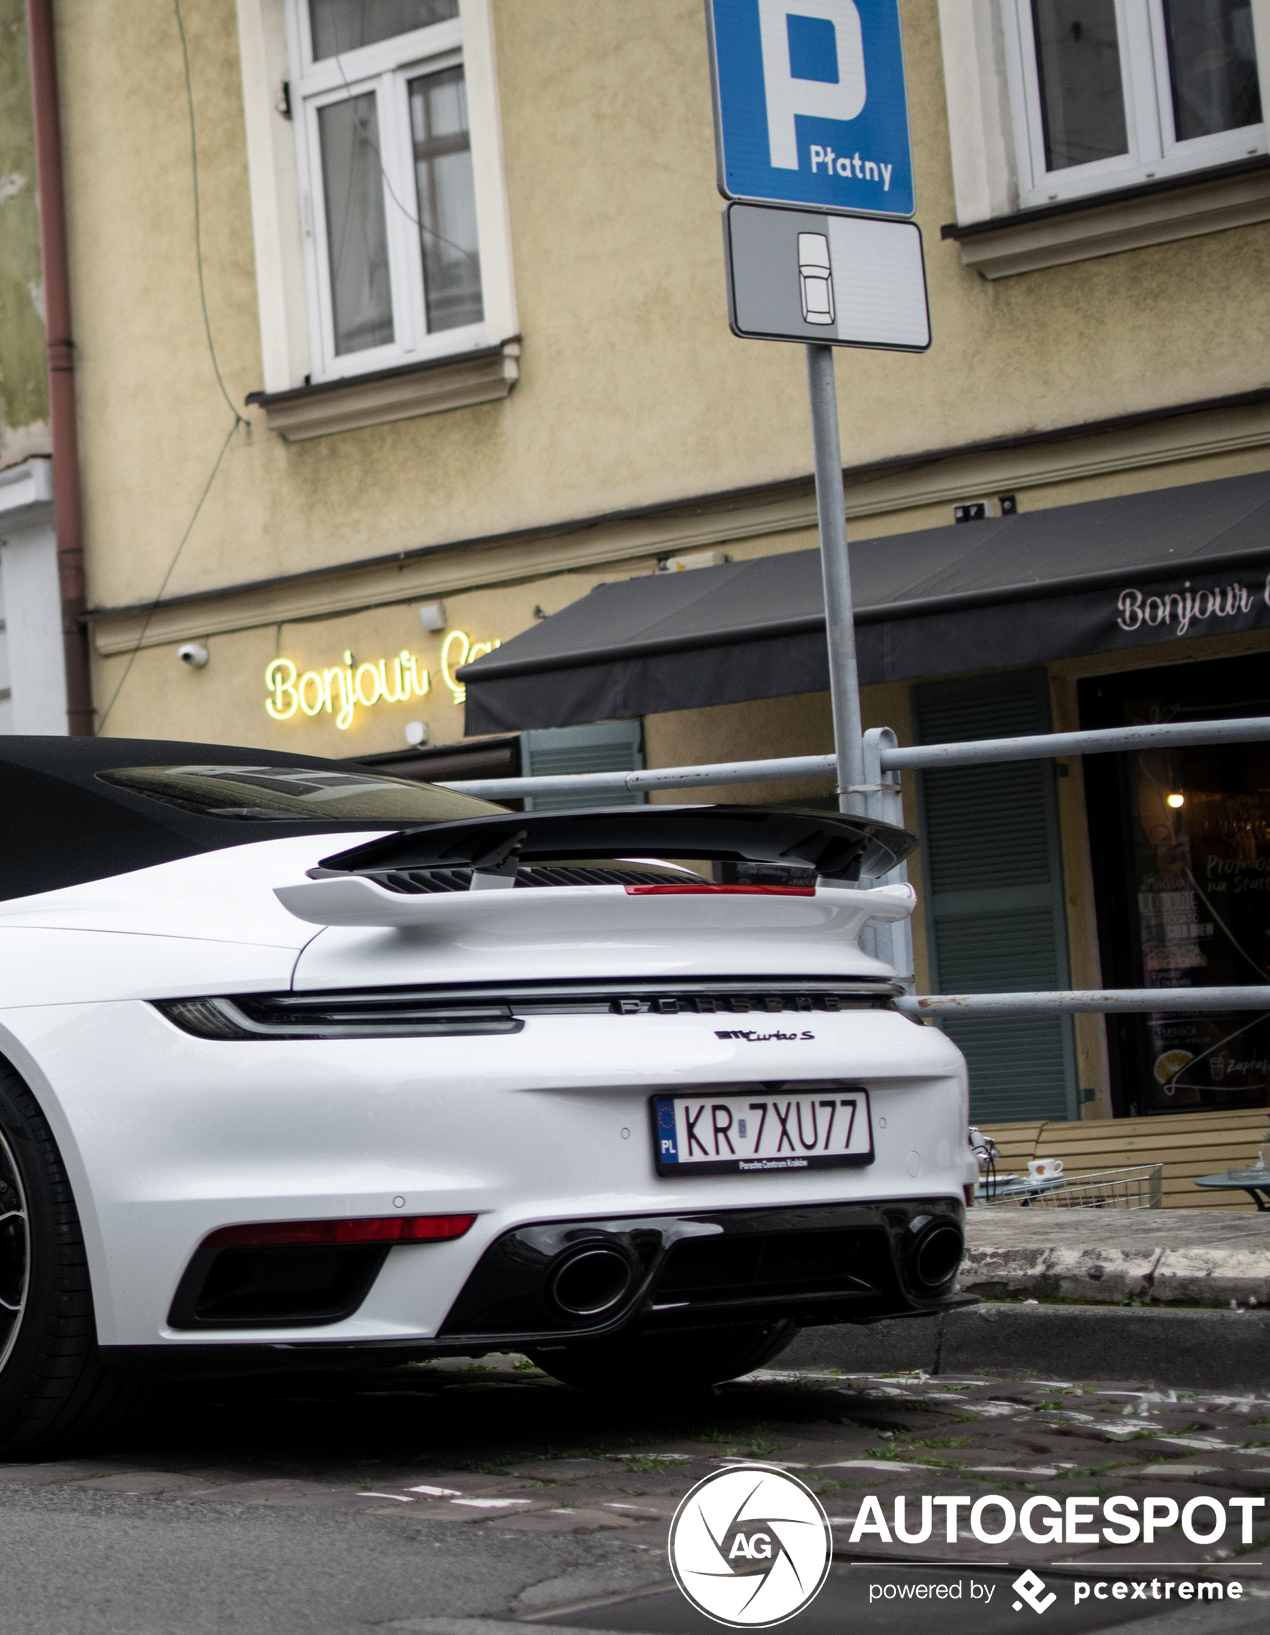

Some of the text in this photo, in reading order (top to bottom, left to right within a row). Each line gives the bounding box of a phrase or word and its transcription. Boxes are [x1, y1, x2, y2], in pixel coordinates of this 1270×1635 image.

[759, 0, 866, 170] P
[810, 144, 893, 191] Płatny
[1117, 580, 1254, 637] Bonjour
[265, 650, 430, 731] Bonjour
[661, 1140, 677, 1154] PL
[685, 1099, 858, 1156] KR 7XU77
[739, 1158, 808, 1170] Porsche Centrum Kraków
